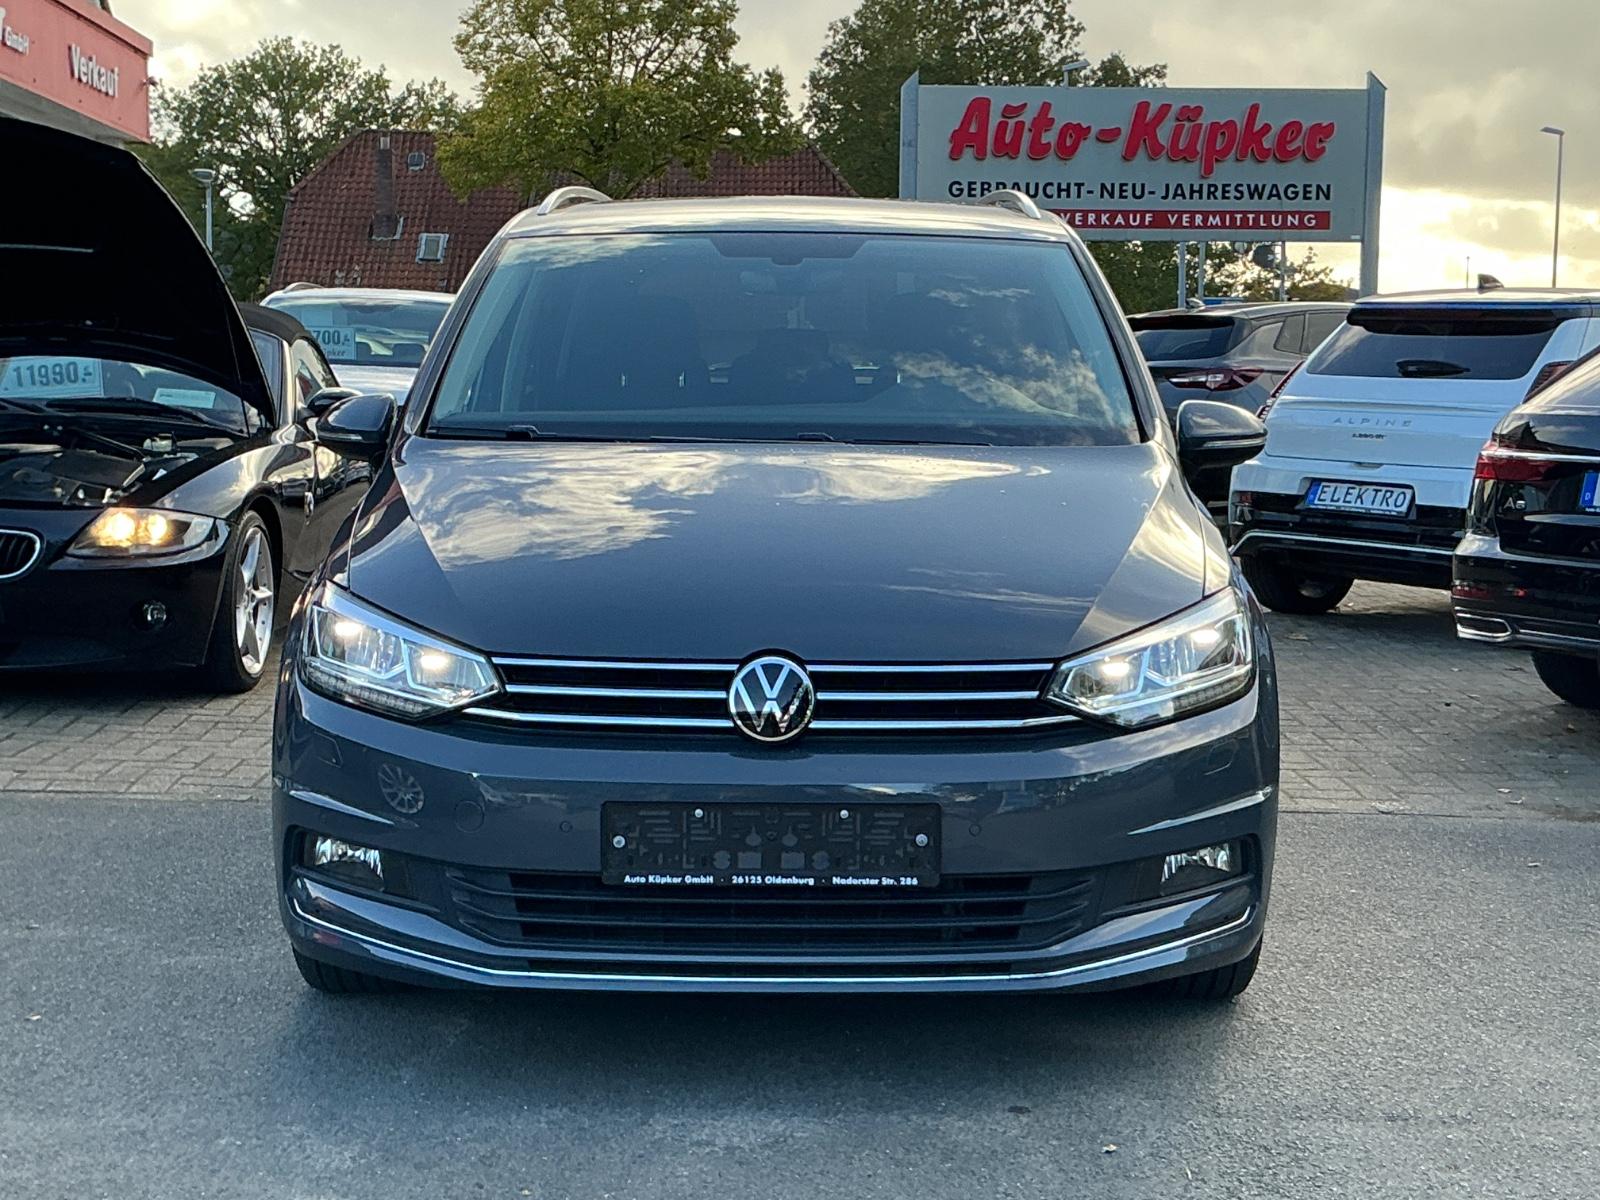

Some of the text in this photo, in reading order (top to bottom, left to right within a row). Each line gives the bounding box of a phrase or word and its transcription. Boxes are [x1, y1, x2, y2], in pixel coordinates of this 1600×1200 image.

[71, 43, 119, 98] Verkauf
[1061, 212, 1317, 228] VERKAUF VERMITTLUNG
[1333, 417, 1412, 427] ALPINE
[1317, 484, 1407, 508] ELEKTRO
[733, 660, 811, 735] VW
[624, 875, 646, 883] Auto
[648, 875, 682, 885] Küpker
[684, 875, 714, 884] GmbH
[732, 875, 762, 884] 26125
[765, 875, 815, 886] Oldenburg
[881, 876, 898, 885] Str.
[900, 877, 919, 885] 286
